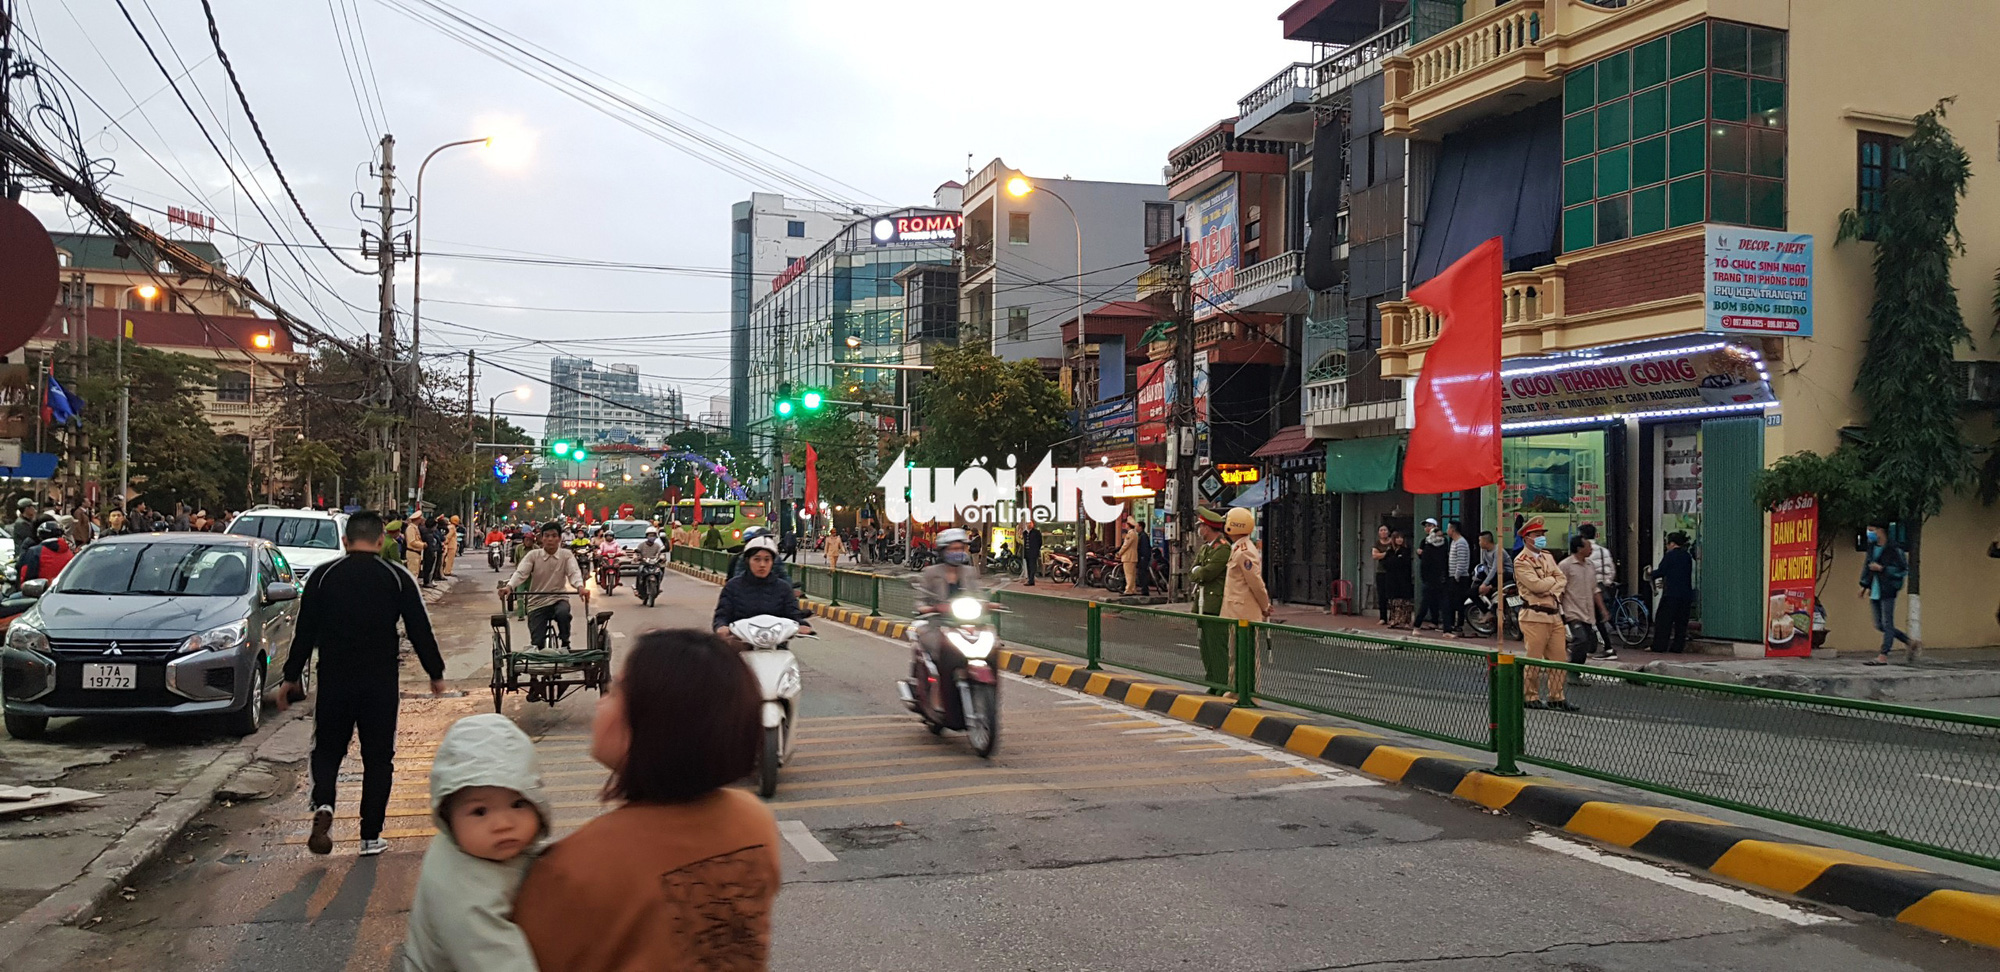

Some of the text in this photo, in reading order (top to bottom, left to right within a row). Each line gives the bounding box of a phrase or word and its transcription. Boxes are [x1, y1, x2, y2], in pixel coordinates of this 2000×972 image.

[1738, 239, 1770, 251] DECOR
[1759, 261, 1779, 272] SINH
[1713, 272, 1741, 283] TRANG
[1760, 289, 1791, 300] TRANG
[1773, 304, 1807, 315] HIDRO
[1630, 358, 1696, 385] CÔNG
[1527, 403, 1537, 413] XE
[1537, 401, 1550, 412] VIP
[1556, 399, 1568, 410] XE
[1615, 396, 1626, 405] XE
[1649, 387, 1700, 401] ROADSHOW
[1773, 514, 1813, 545] BÁNH CÁY
[100, 666, 120, 676] 17A
[90, 677, 130, 688] 197.72
